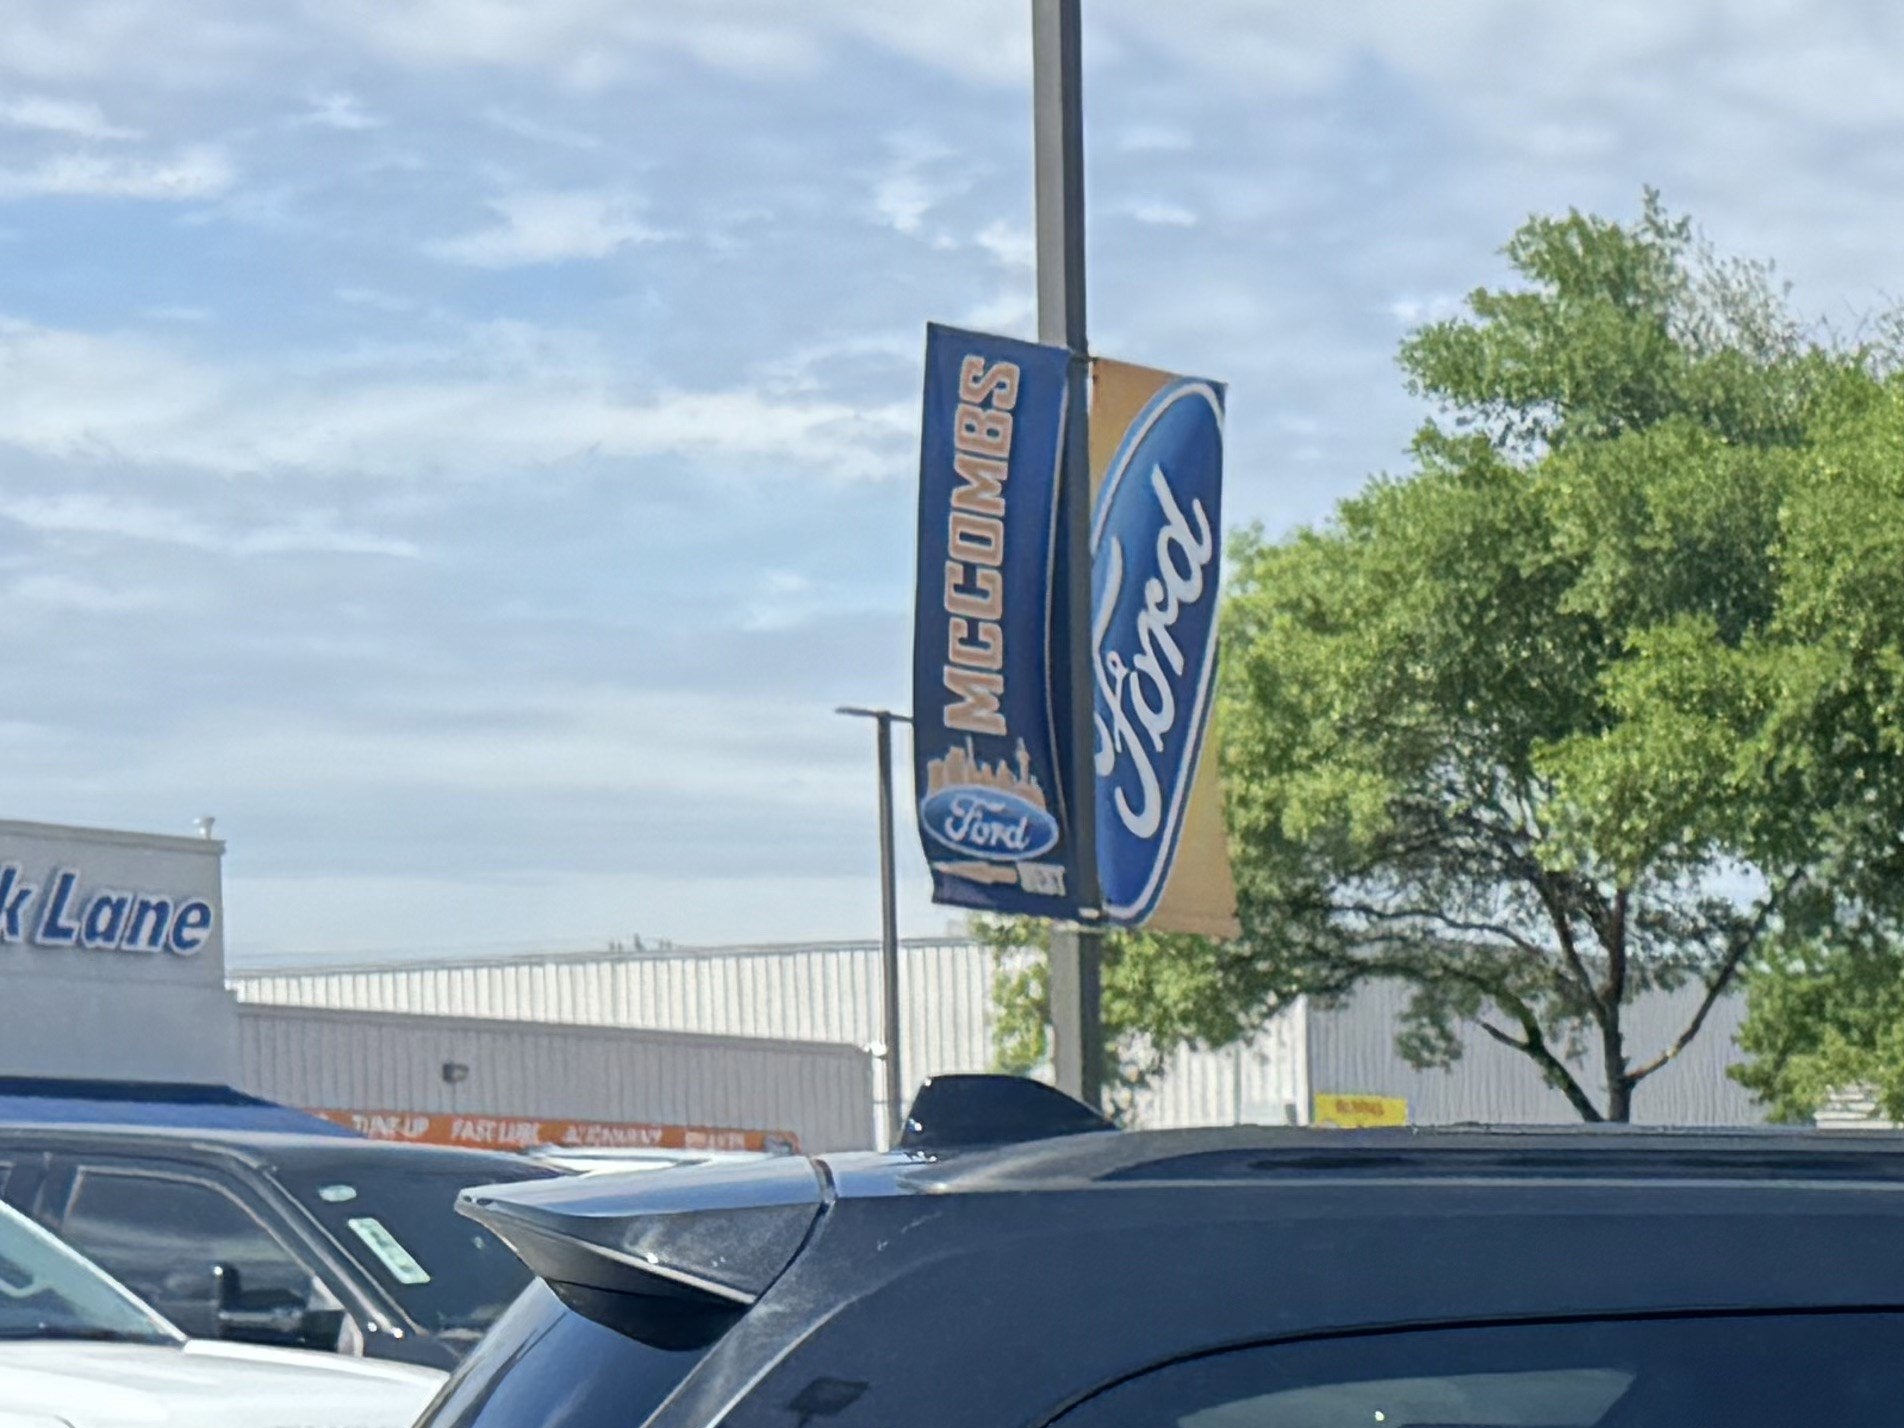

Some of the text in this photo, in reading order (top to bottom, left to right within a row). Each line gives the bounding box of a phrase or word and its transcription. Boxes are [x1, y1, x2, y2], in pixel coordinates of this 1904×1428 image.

[1092, 474, 1213, 841] Ford
[944, 797, 1031, 851] Ford
[35, 867, 214, 956] Lane
